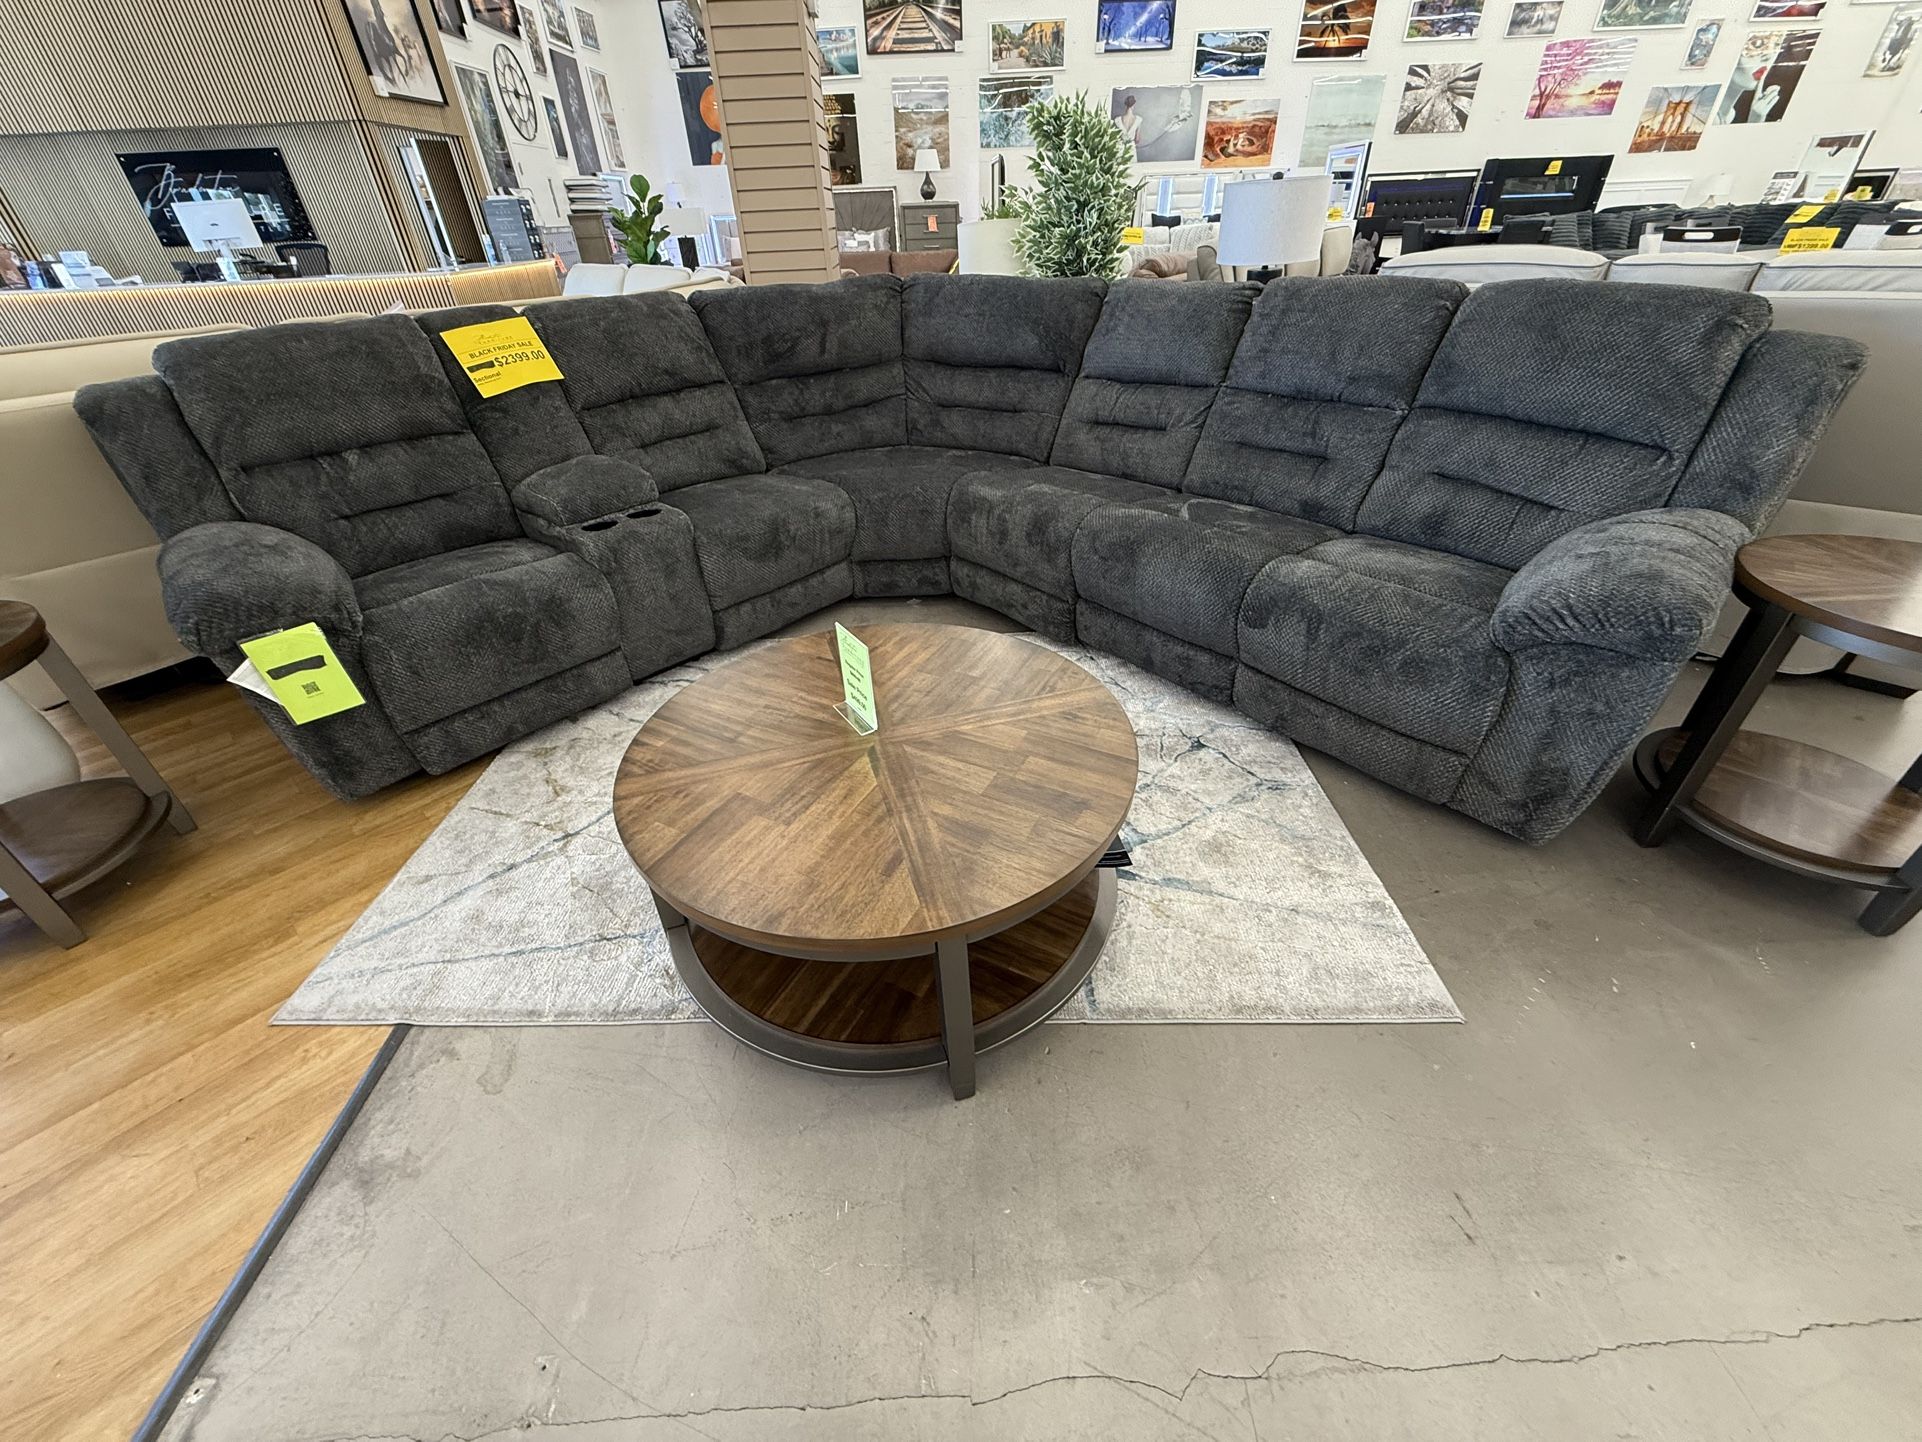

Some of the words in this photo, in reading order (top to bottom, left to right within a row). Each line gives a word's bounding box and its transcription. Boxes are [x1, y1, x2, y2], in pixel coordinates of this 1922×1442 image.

[469, 349, 493, 359] BLACK
[494, 343, 515, 352] FRIDAY
[516, 340, 533, 348] SALE
[494, 350, 545, 367] $2399.00
[473, 371, 502, 384] Sectional
